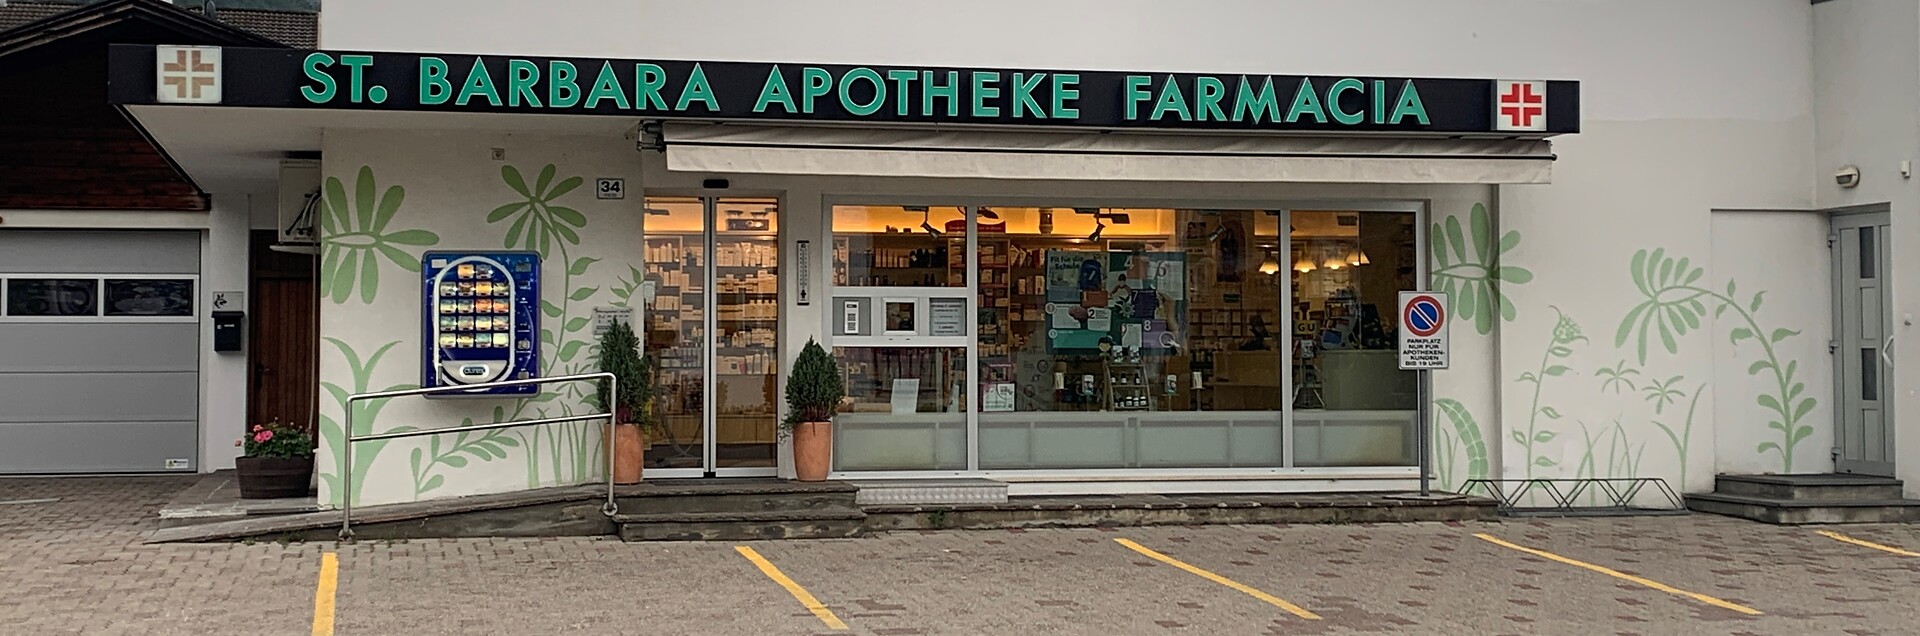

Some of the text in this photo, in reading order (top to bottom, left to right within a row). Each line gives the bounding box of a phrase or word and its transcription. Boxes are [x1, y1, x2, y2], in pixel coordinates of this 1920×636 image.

[301, 52, 1429, 125] ST. BARBARA APOTHEKE FARMACIA
[600, 181, 620, 192] 34
[1124, 255, 1134, 270] 4
[1132, 290, 1138, 302] 7
[1088, 309, 1095, 319] 2
[1143, 320, 1152, 331] 8
[1297, 323, 1315, 332] GU
